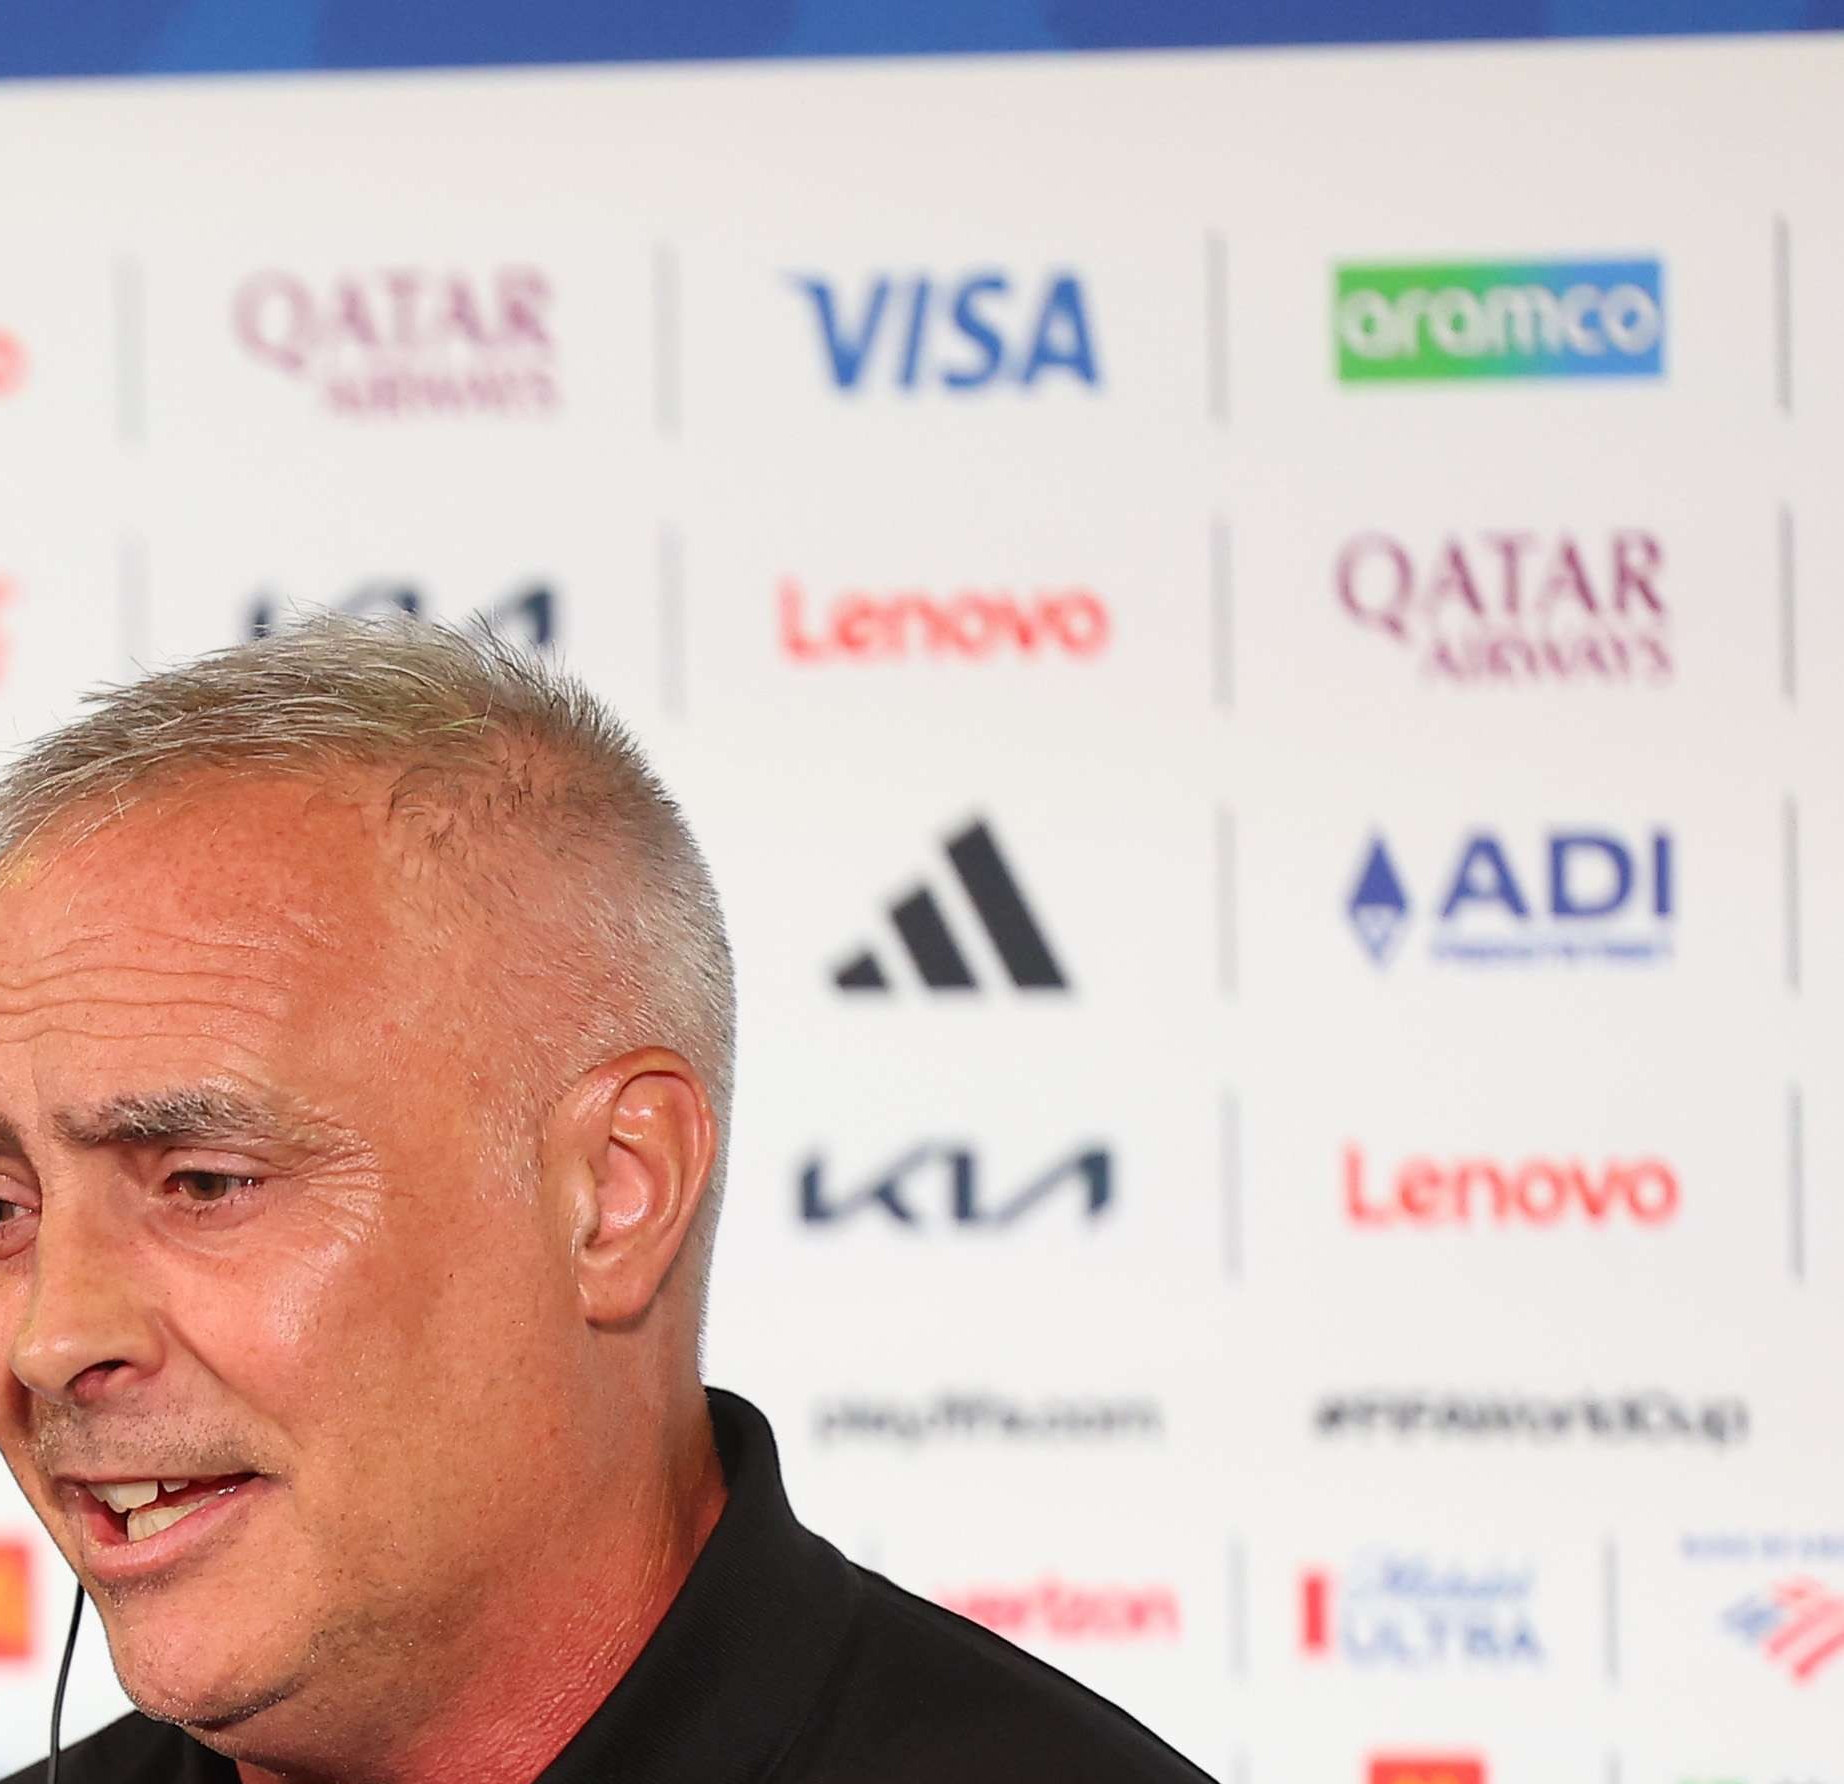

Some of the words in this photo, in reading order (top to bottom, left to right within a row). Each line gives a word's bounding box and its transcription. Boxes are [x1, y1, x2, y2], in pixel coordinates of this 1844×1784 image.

[233, 266, 554, 374] QATAR
[791, 270, 1102, 392] VISA
[1339, 282, 1661, 360] aramco
[779, 578, 1111, 664] Lenovo
[1333, 530, 1666, 644] QATAR
[1423, 626, 1675, 685] AIRWAYS
[1439, 830, 1674, 920] ADI
[1342, 1144, 1681, 1227] Lenovo
